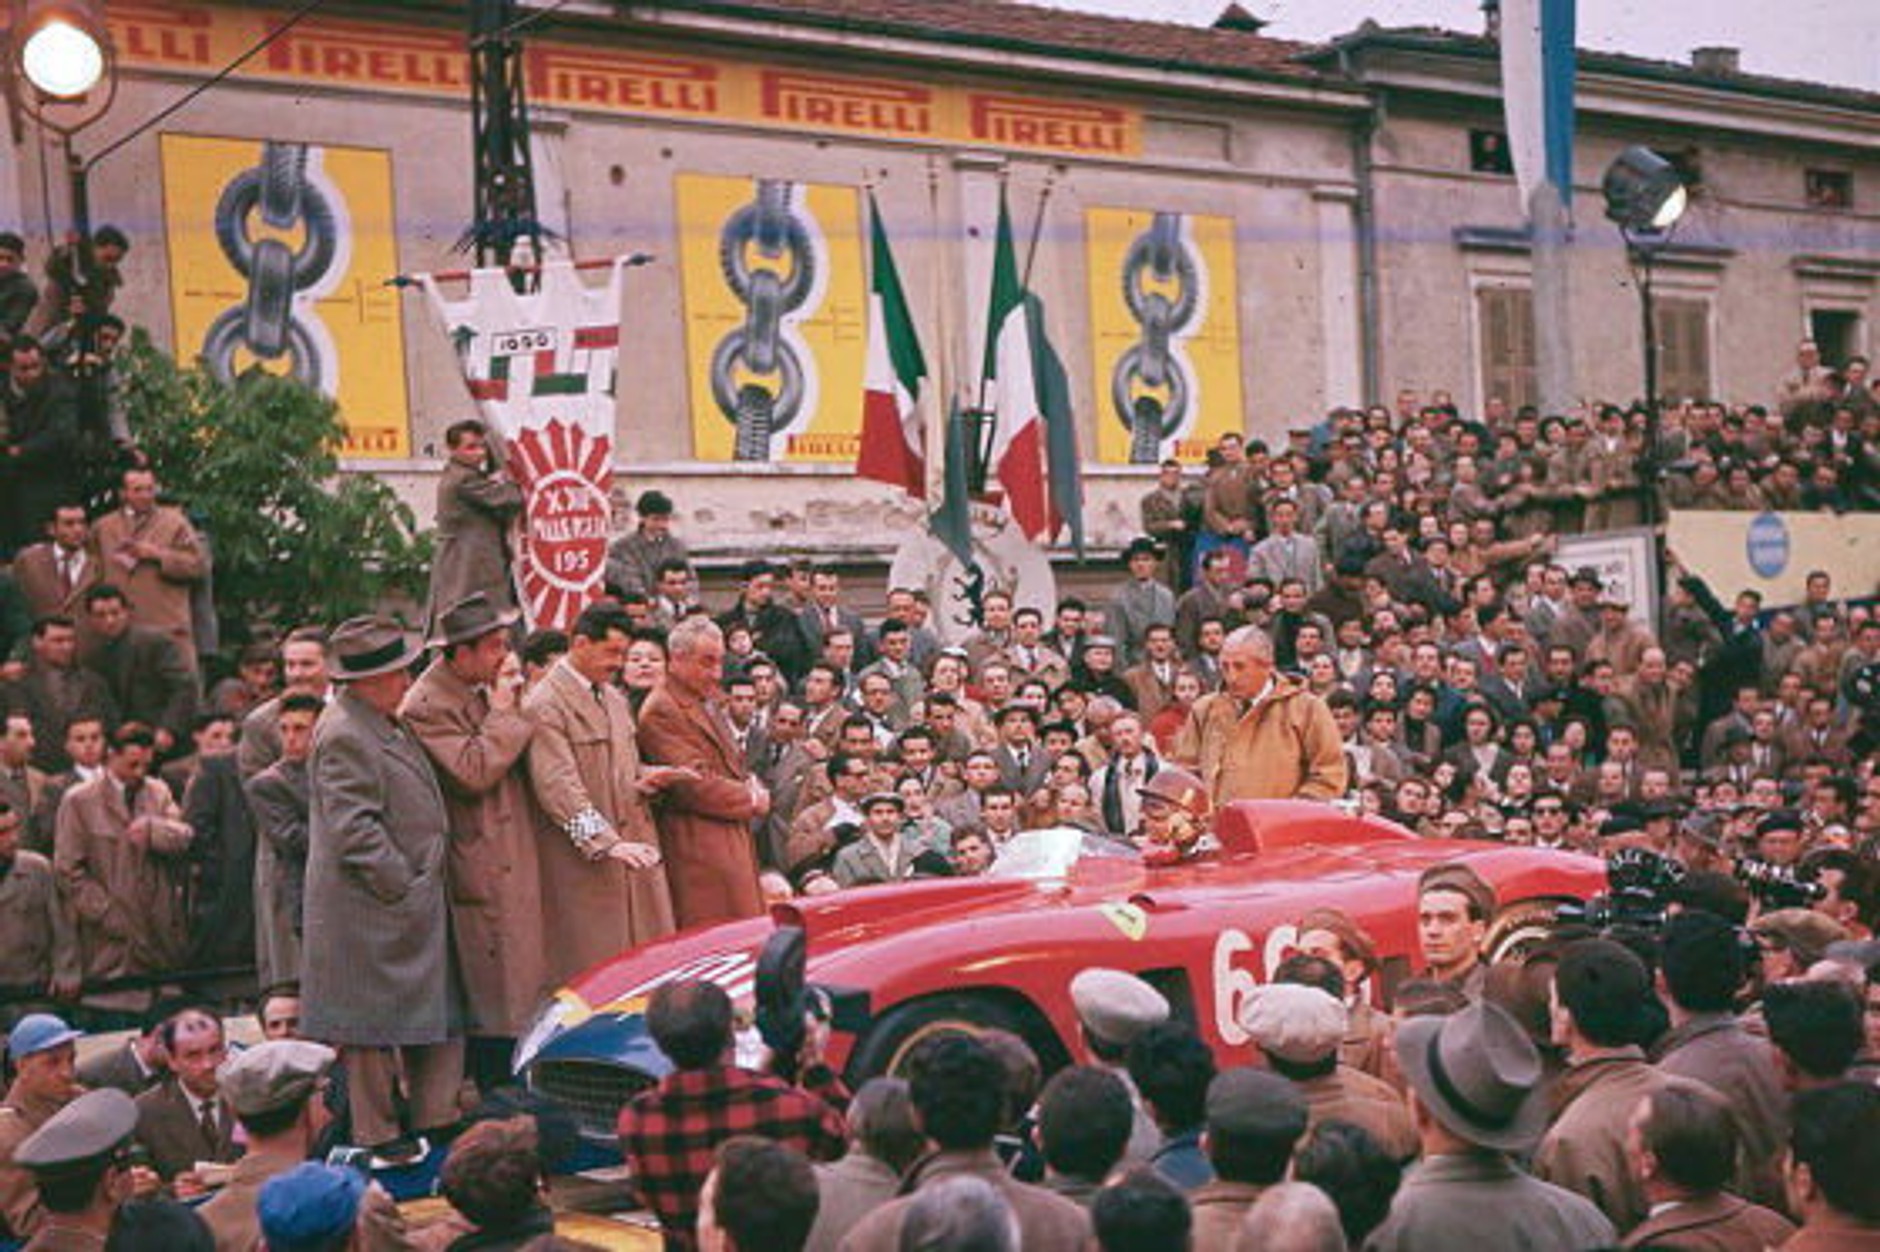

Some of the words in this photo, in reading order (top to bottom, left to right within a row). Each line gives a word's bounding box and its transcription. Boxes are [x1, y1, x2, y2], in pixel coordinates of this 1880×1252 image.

[528, 45, 720, 111] PIRELLI
[761, 69, 932, 133] PIRELLI
[969, 94, 1126, 151] PIRELLI
